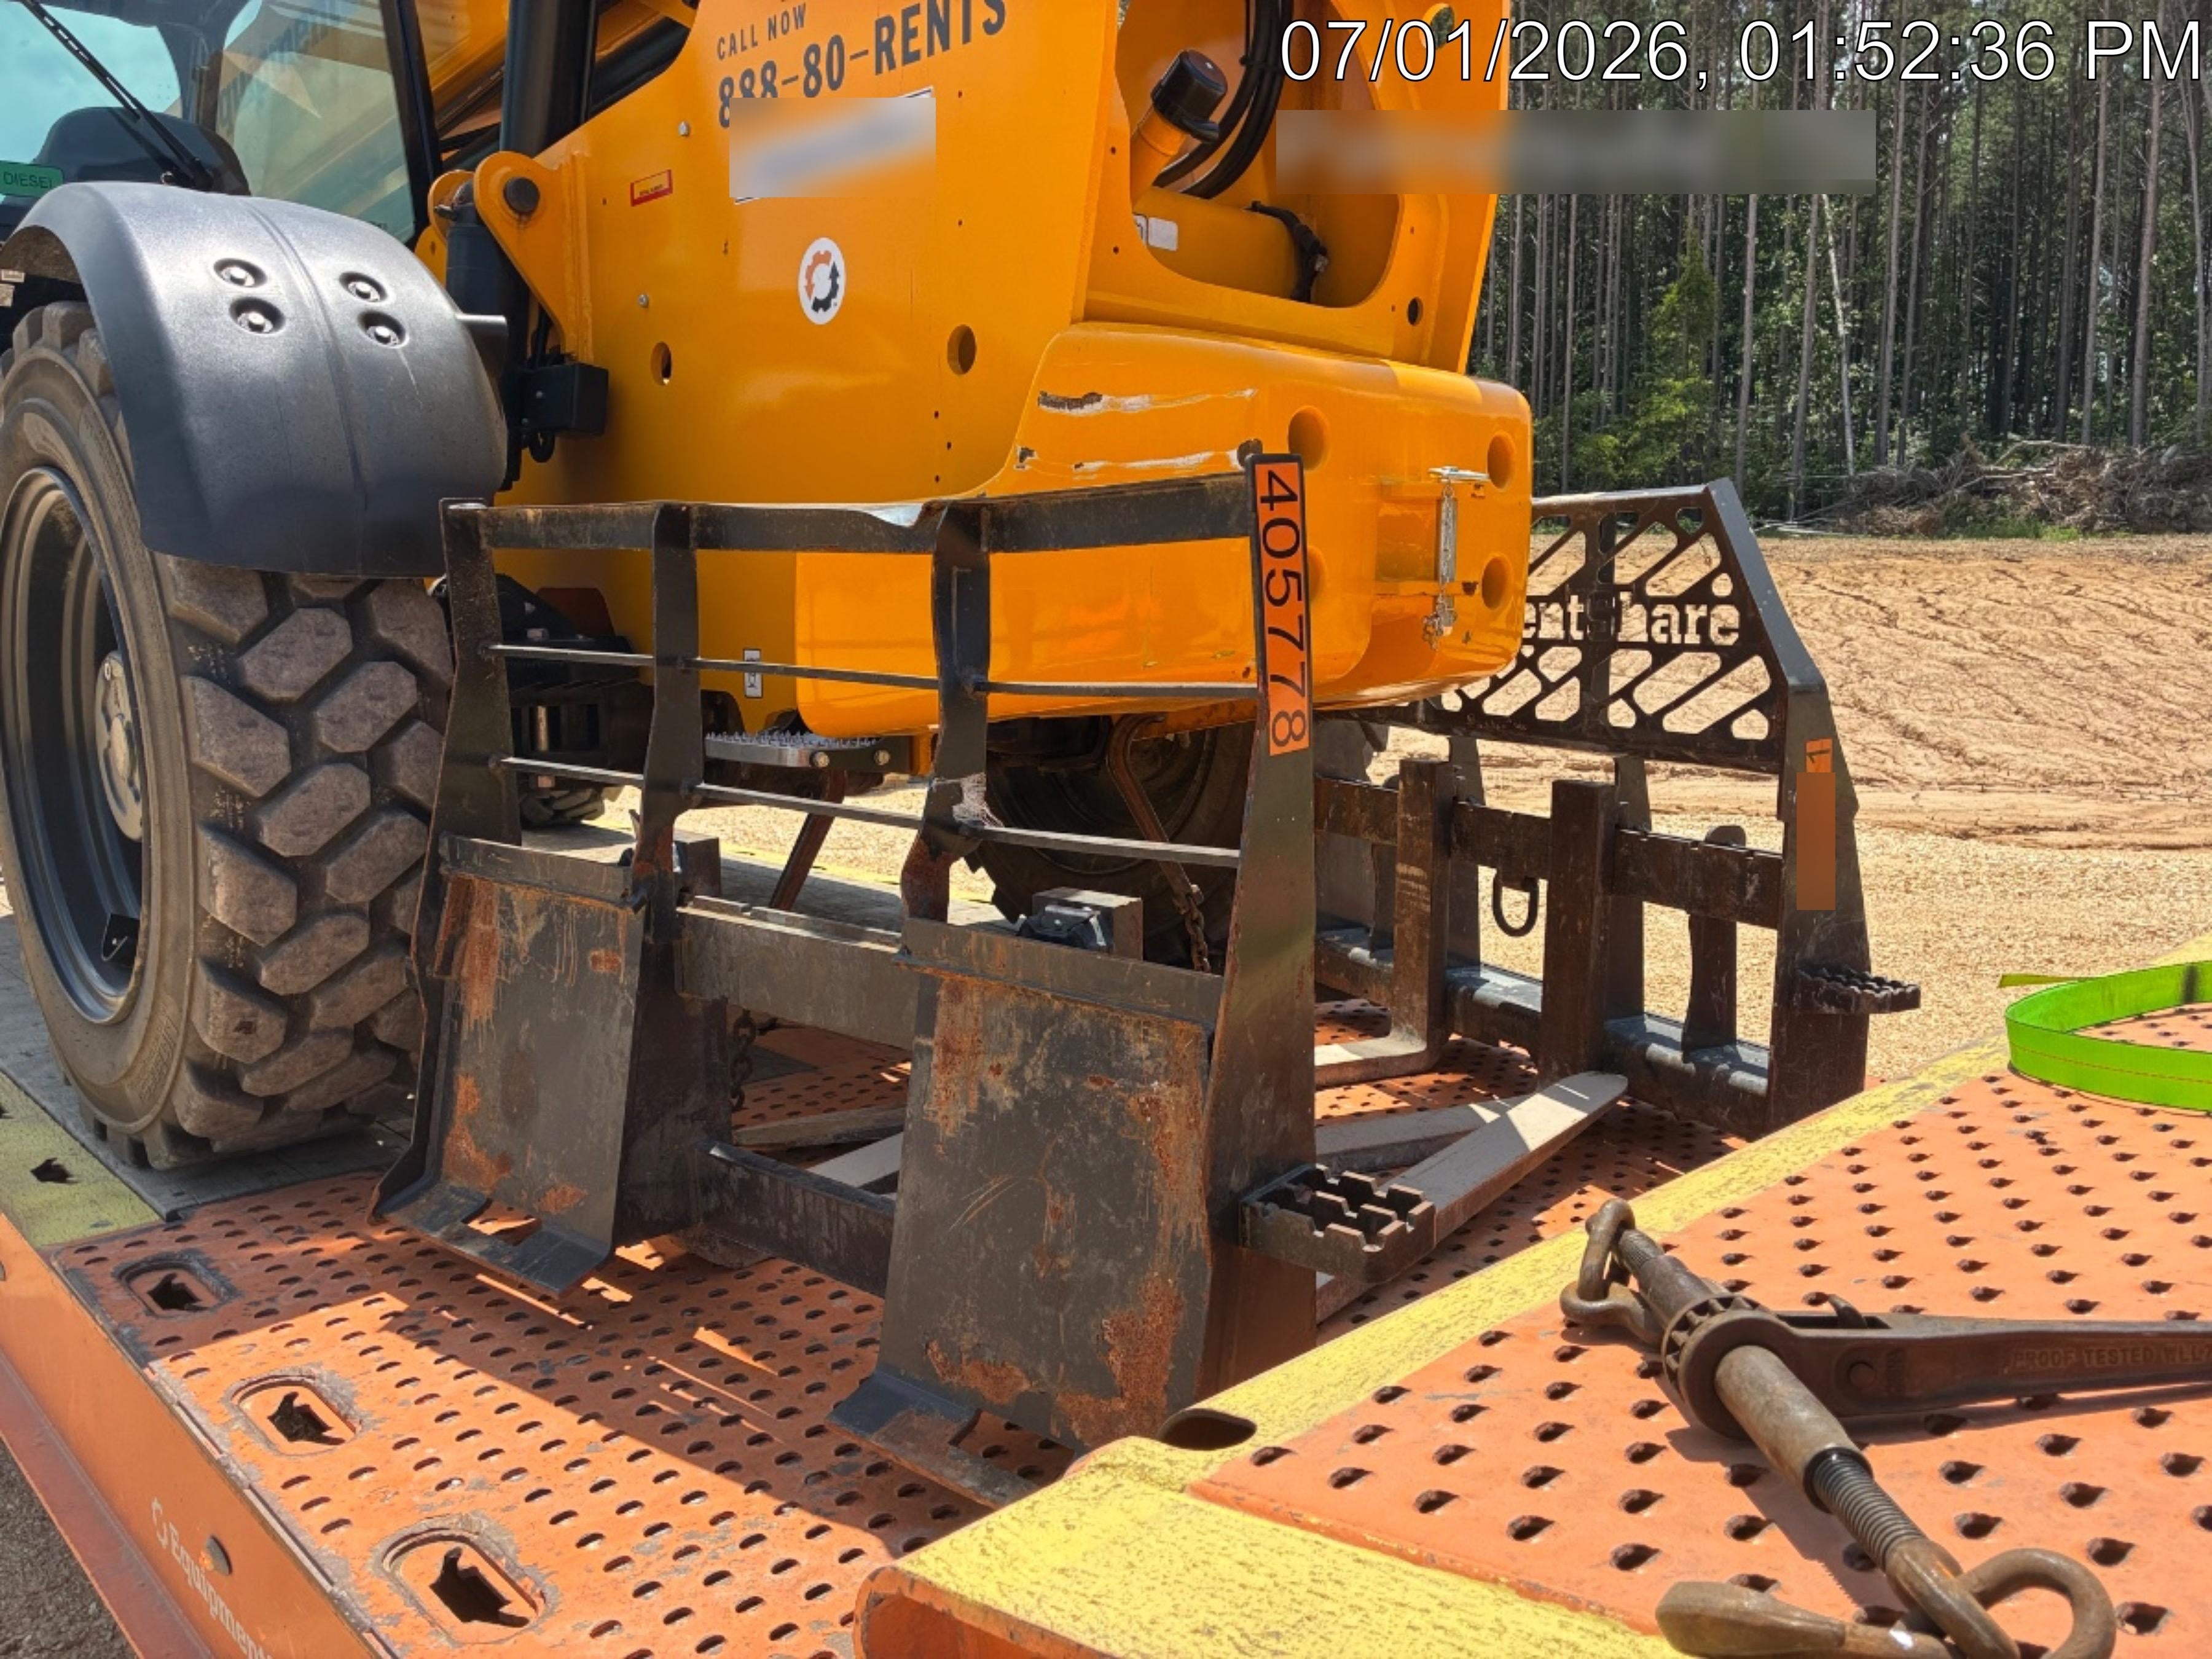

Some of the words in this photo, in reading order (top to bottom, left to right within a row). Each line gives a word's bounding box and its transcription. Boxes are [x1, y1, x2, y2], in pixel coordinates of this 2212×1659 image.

[717, 24, 758, 60] CALL
[767, 2, 806, 41] NOW
[1260, 469, 1306, 748] 405778
[2013, 1349, 2076, 1369] PROOF
[2084, 1347, 2154, 1367] TESTED
